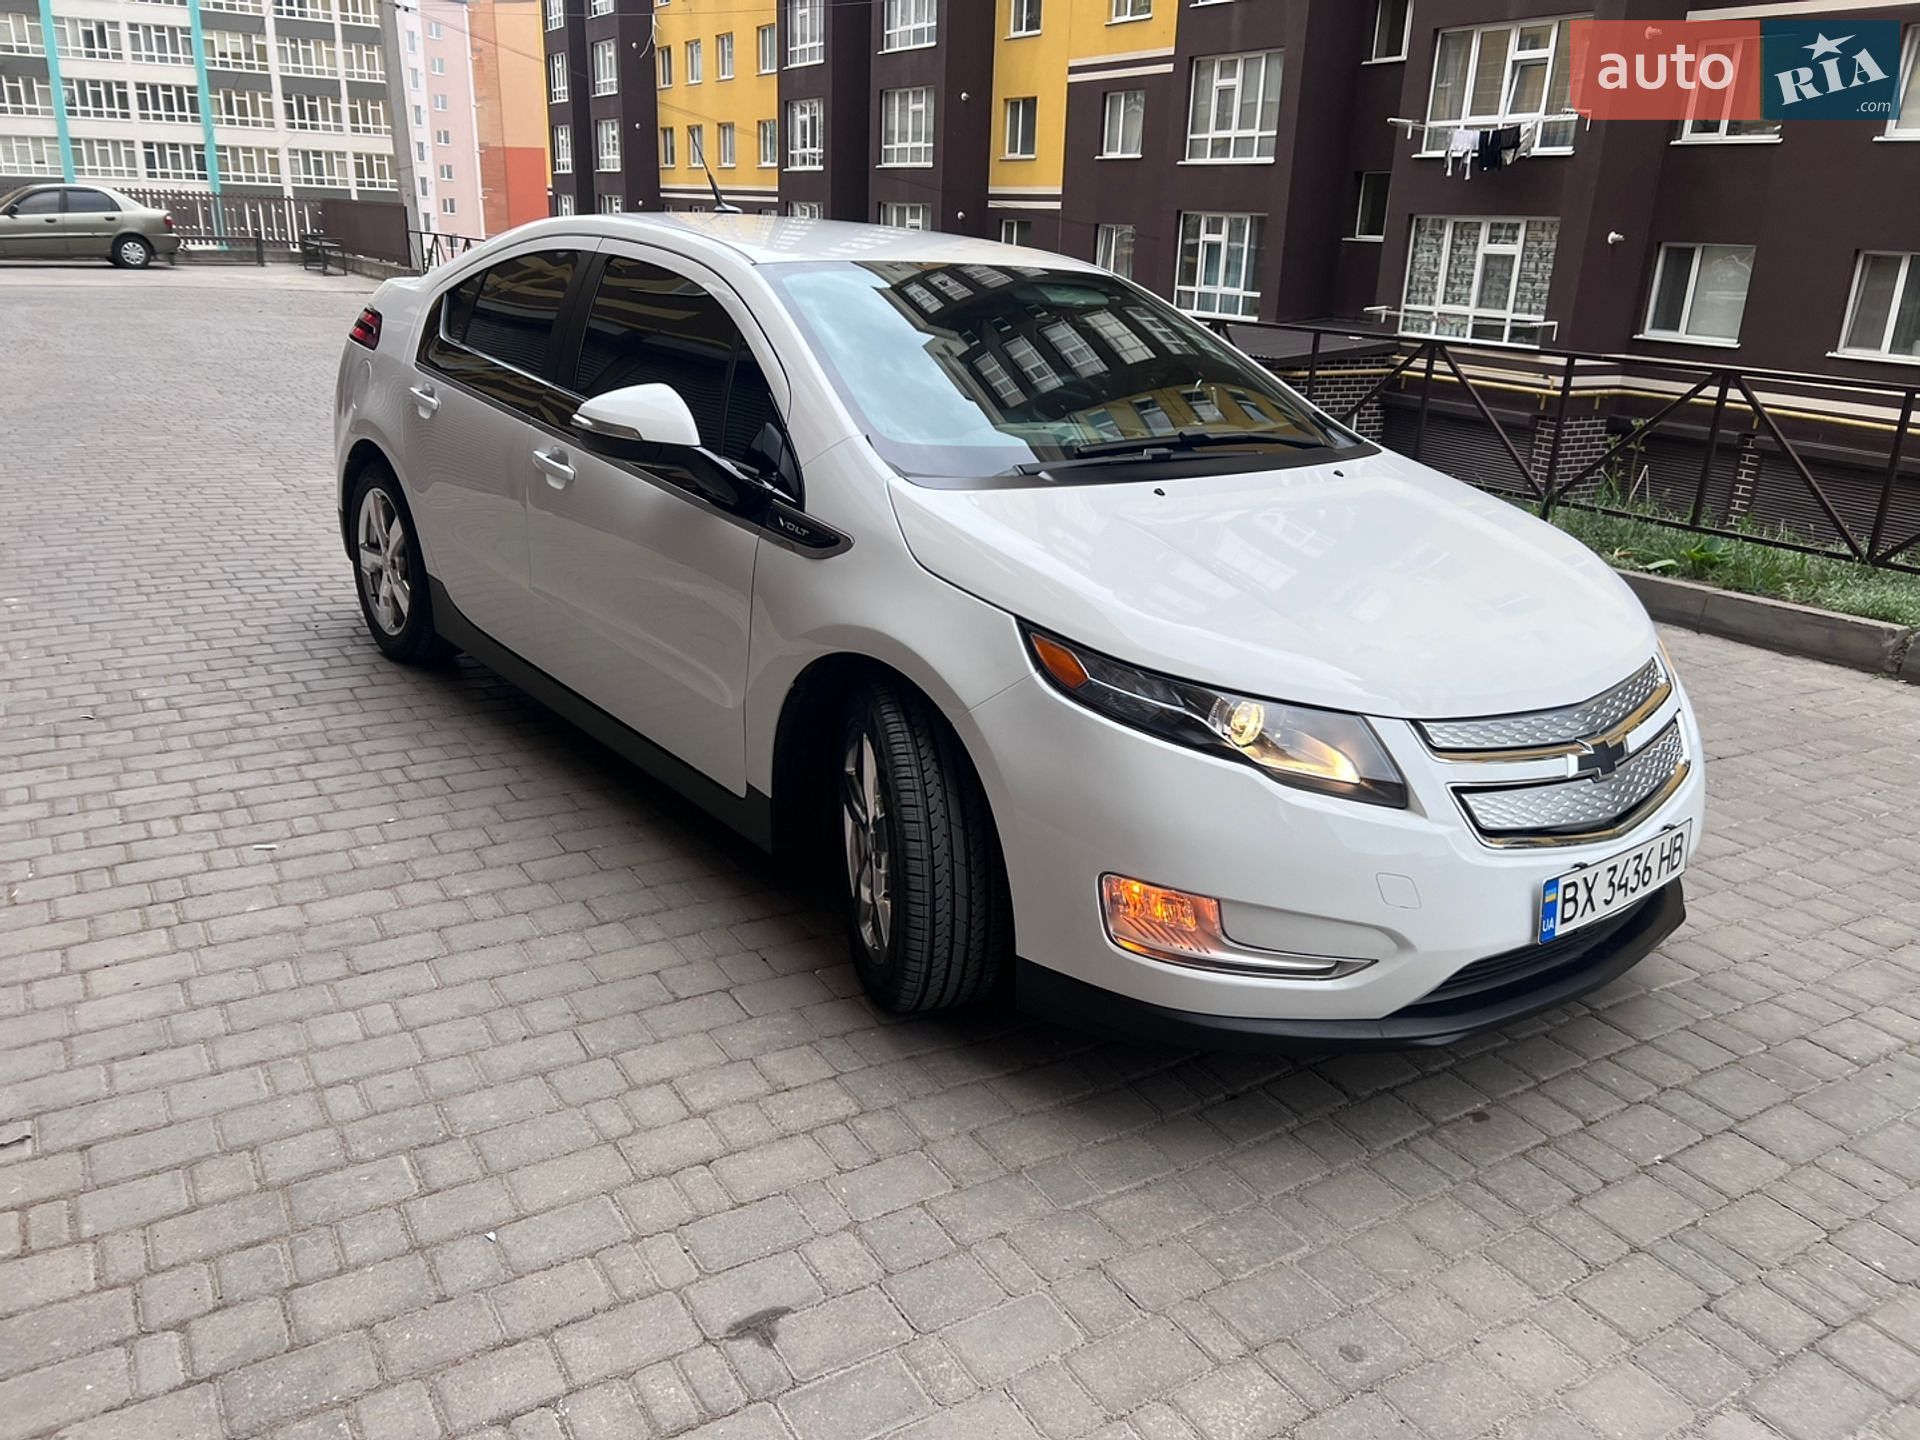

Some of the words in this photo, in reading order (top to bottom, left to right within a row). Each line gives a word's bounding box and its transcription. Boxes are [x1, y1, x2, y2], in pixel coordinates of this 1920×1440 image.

[779, 516, 809, 536] VOLT
[1560, 872, 1599, 925] BX
[1604, 848, 1654, 906] 3436
[1657, 832, 1684, 880] HB
[1542, 918, 1555, 933] UA
